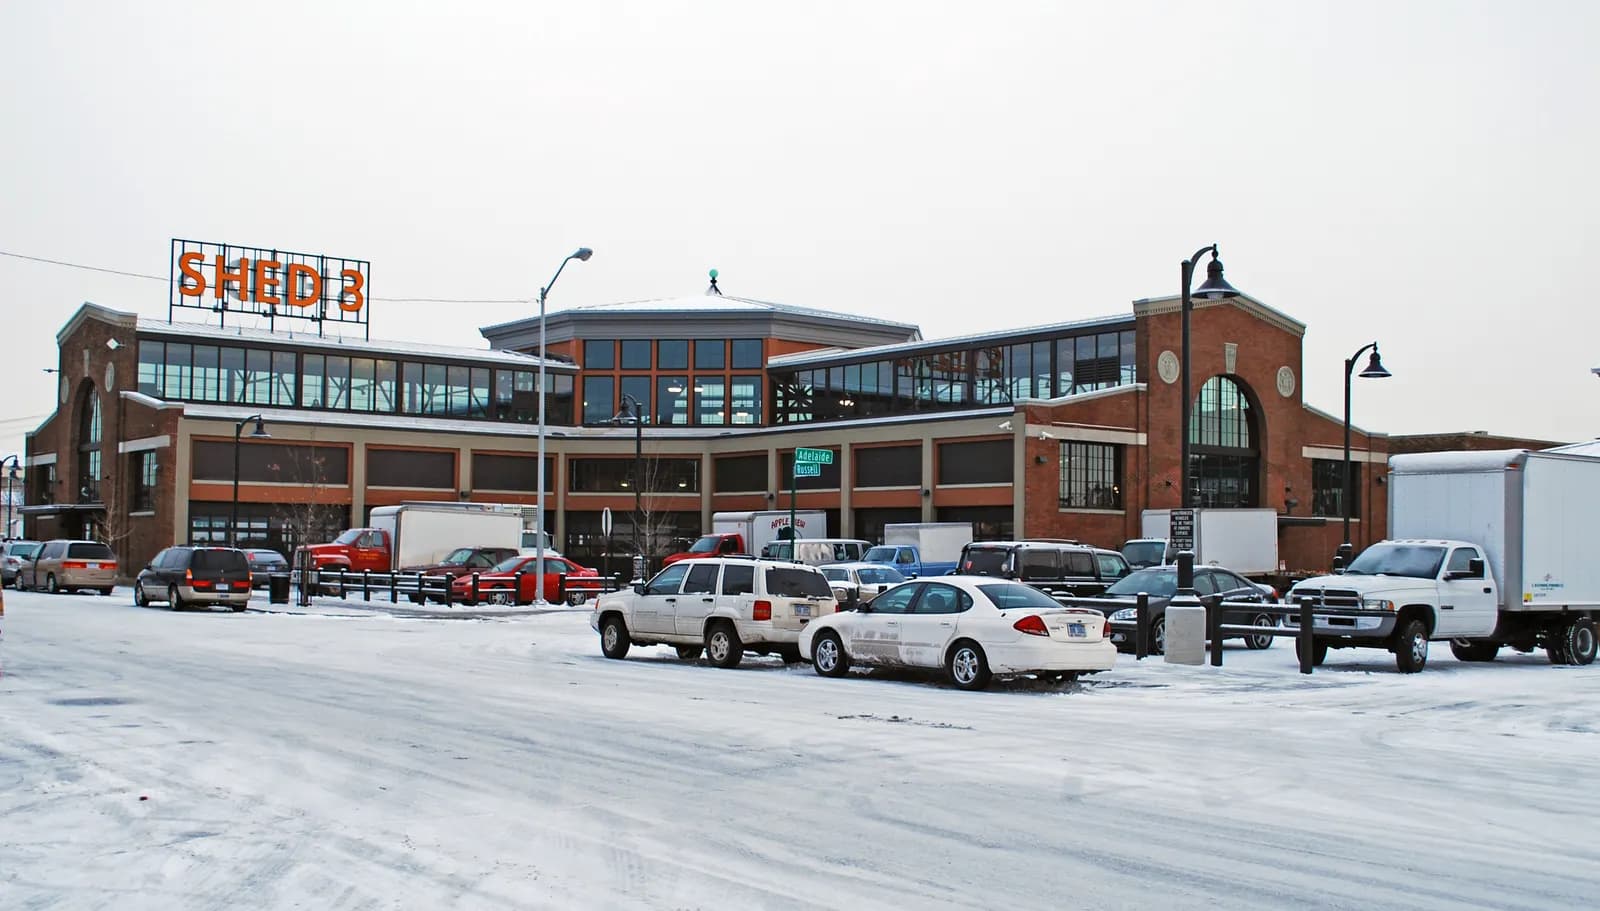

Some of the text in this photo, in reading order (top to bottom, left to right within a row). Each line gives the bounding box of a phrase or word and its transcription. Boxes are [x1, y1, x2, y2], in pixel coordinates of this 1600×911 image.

[178, 252, 365, 312] SHED 3
[798, 450, 830, 462] Adelaide
[797, 464, 818, 474] Russell
[771, 517, 790, 528] APPLE
